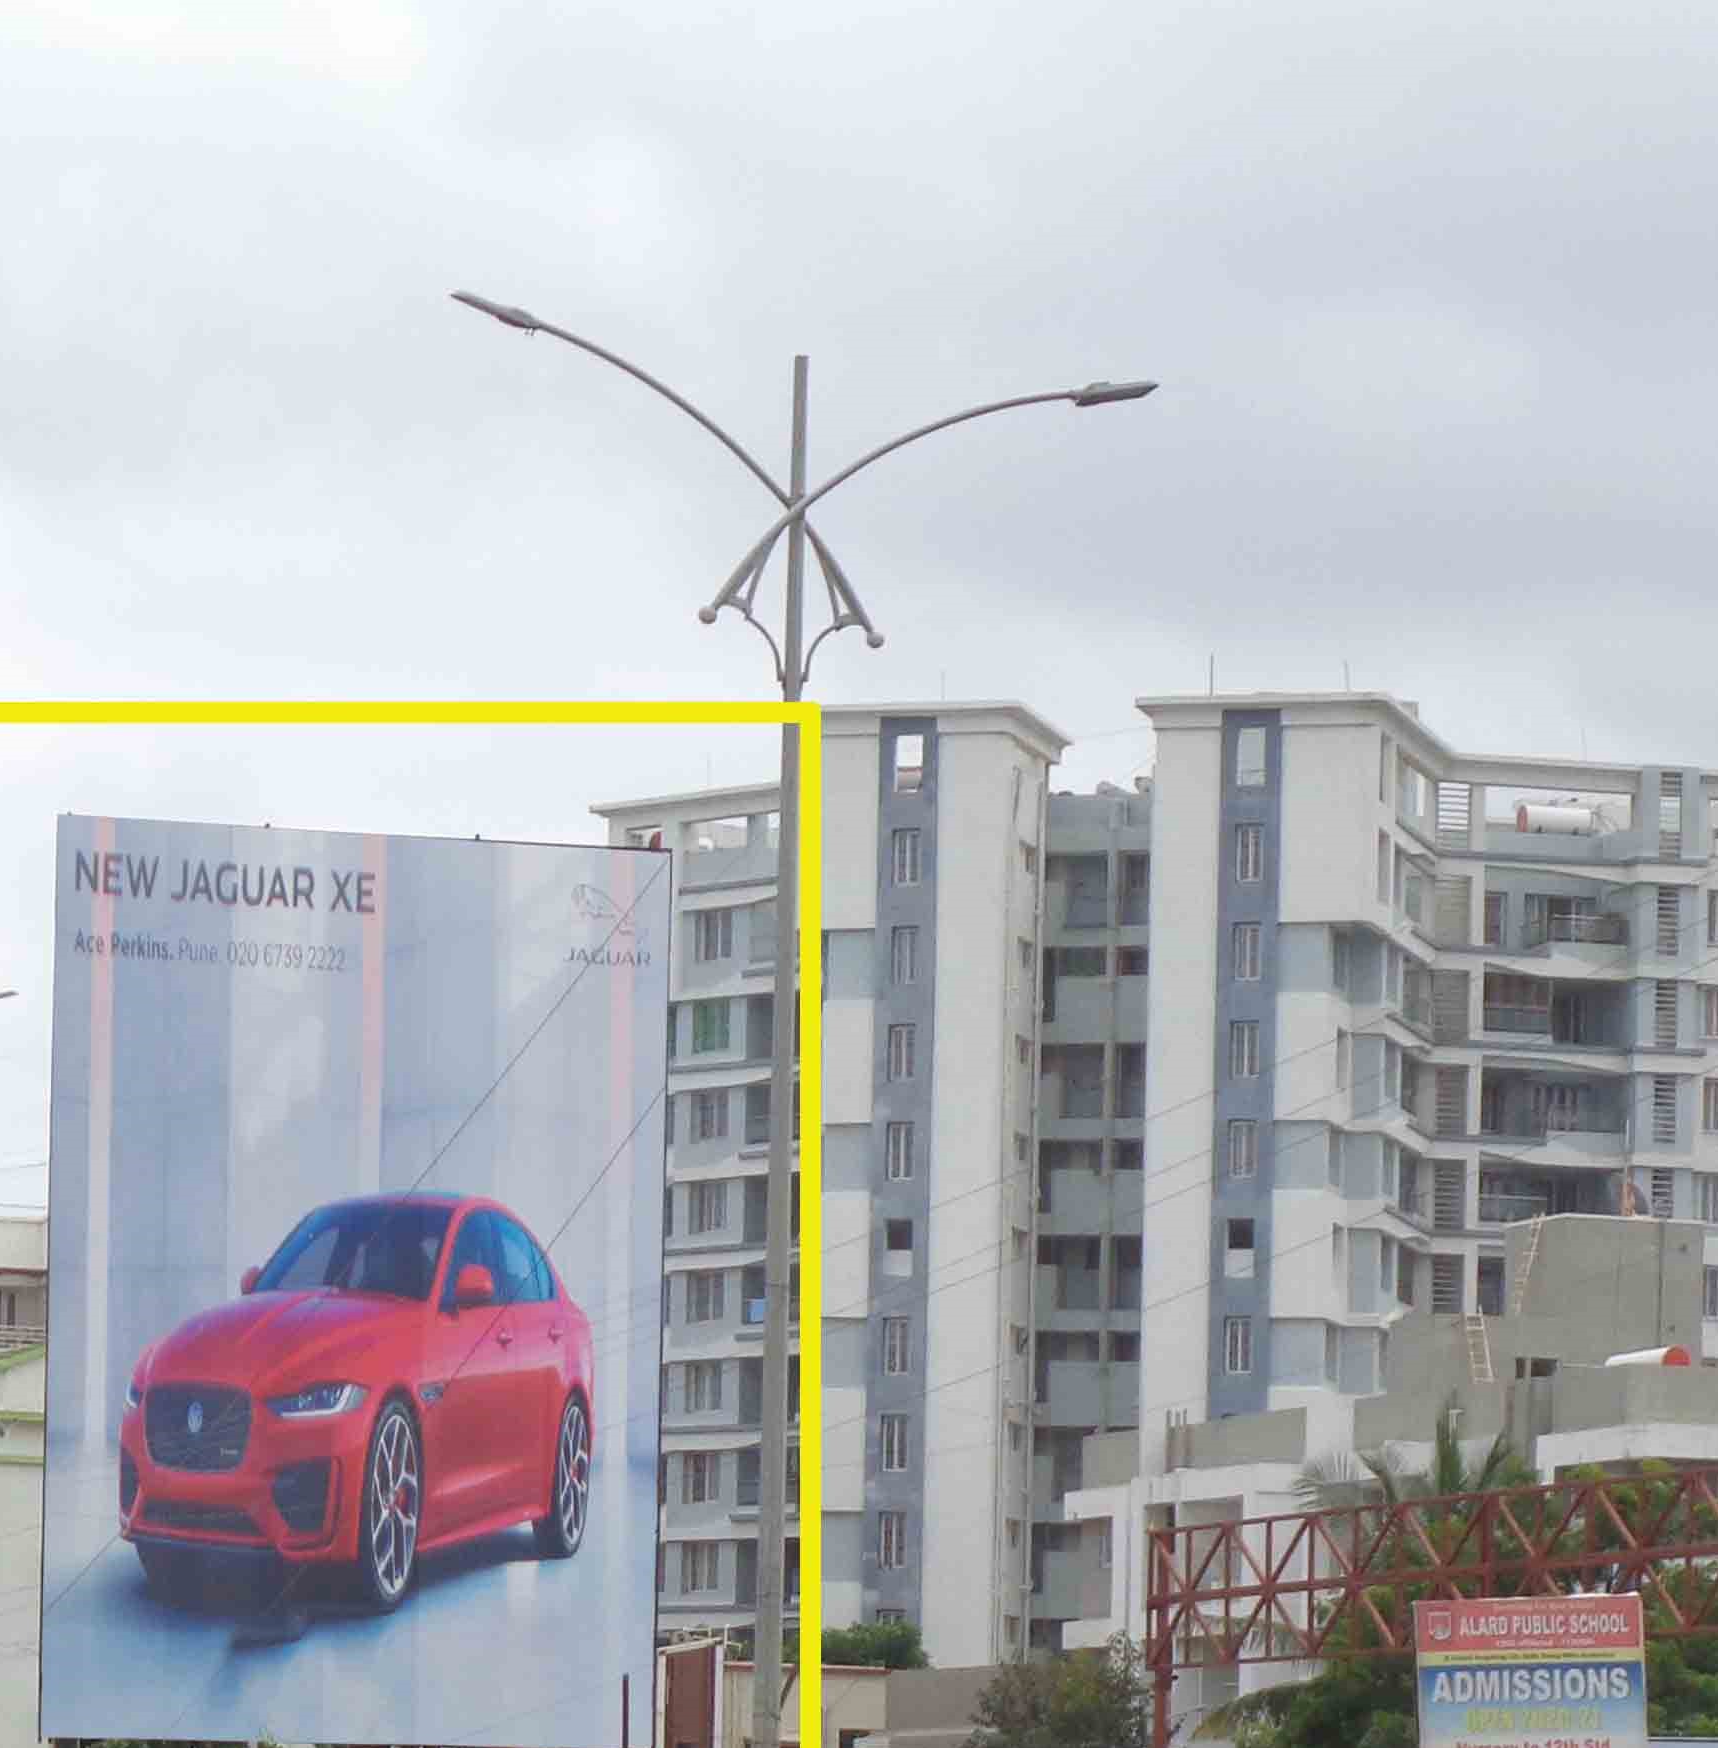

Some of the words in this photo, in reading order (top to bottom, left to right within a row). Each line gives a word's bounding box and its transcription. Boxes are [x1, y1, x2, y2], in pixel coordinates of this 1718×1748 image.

[75, 852, 159, 899] NEW
[171, 859, 315, 909] JAGUAR
[330, 869, 376, 913] XE
[74, 928, 104, 954] Ace
[226, 941, 258, 967] 020
[264, 944, 301, 969] 6739
[307, 946, 345, 972] 2222
[564, 947, 652, 968] JAGUAR
[1459, 1616, 1508, 1636] ALARD
[1513, 1614, 1565, 1635] PUBLIC
[1570, 1613, 1630, 1633] SCHOOL
[1433, 1667, 1630, 1703] ADMISSIONS
